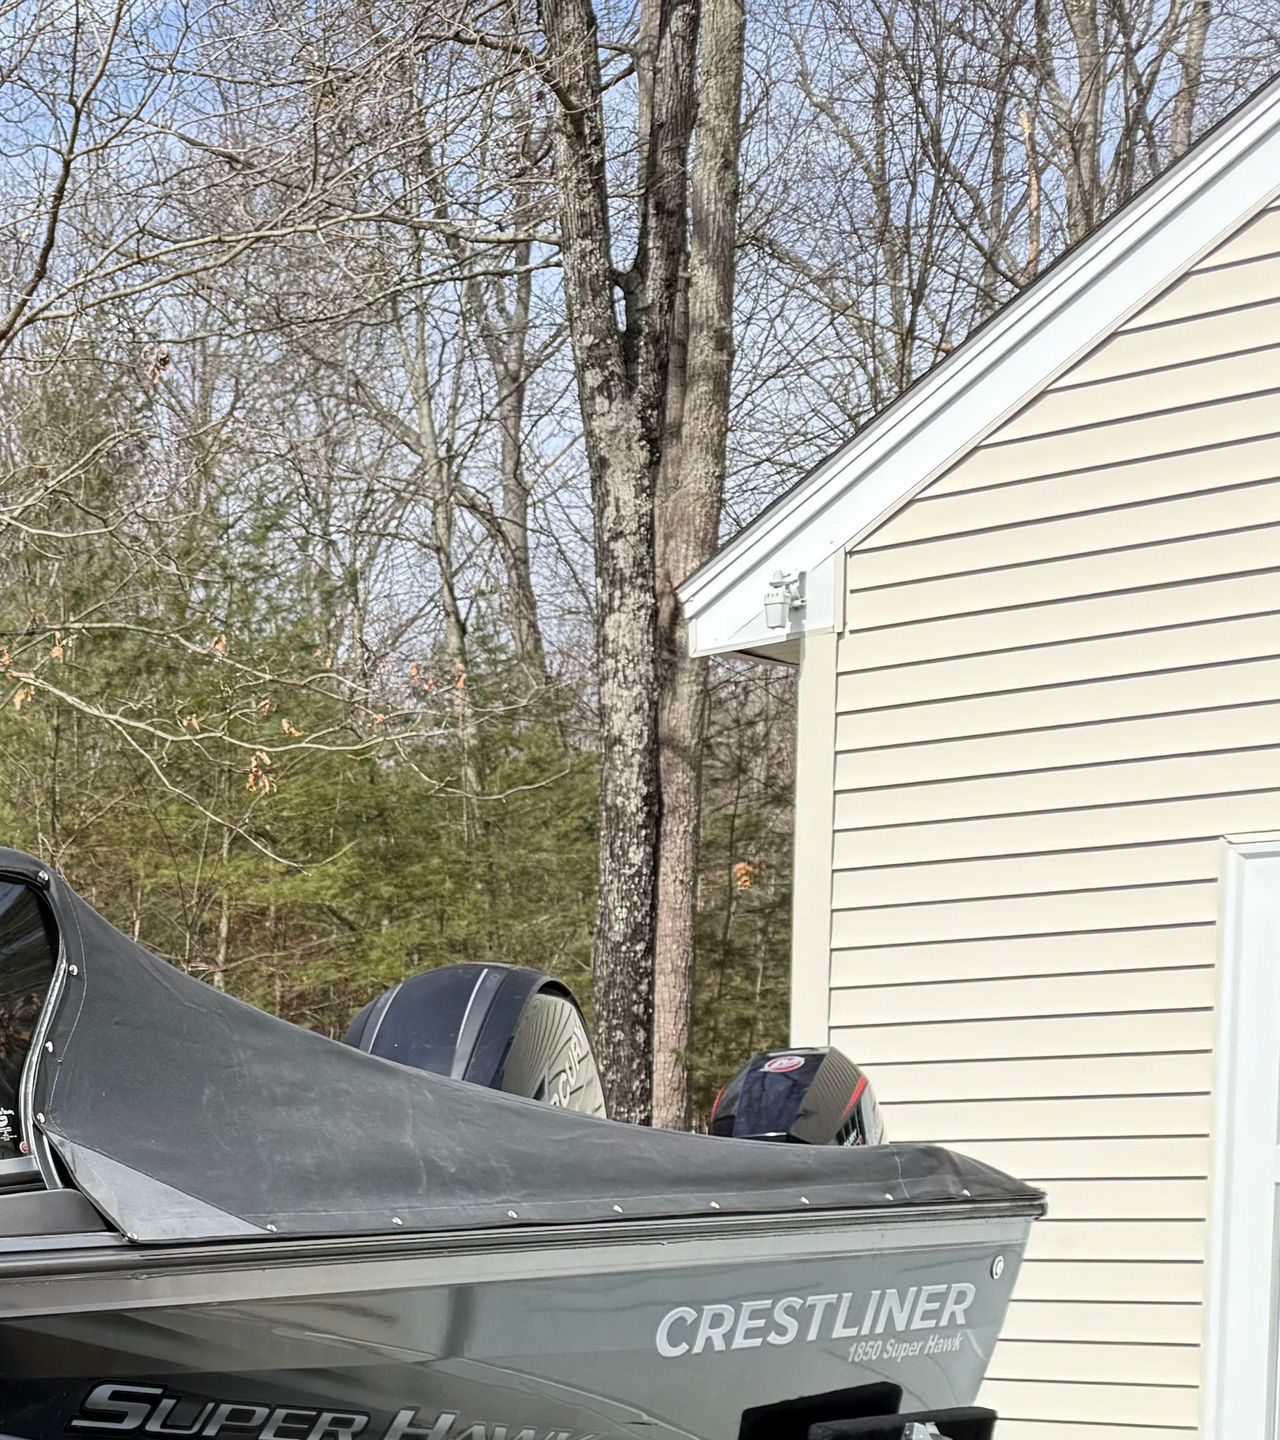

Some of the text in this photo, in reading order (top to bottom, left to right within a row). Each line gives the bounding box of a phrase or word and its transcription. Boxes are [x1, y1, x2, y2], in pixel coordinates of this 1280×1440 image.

[655, 1282, 977, 1358] CRESTLINER
[848, 1332, 963, 1363] 1850 Super Hawk
